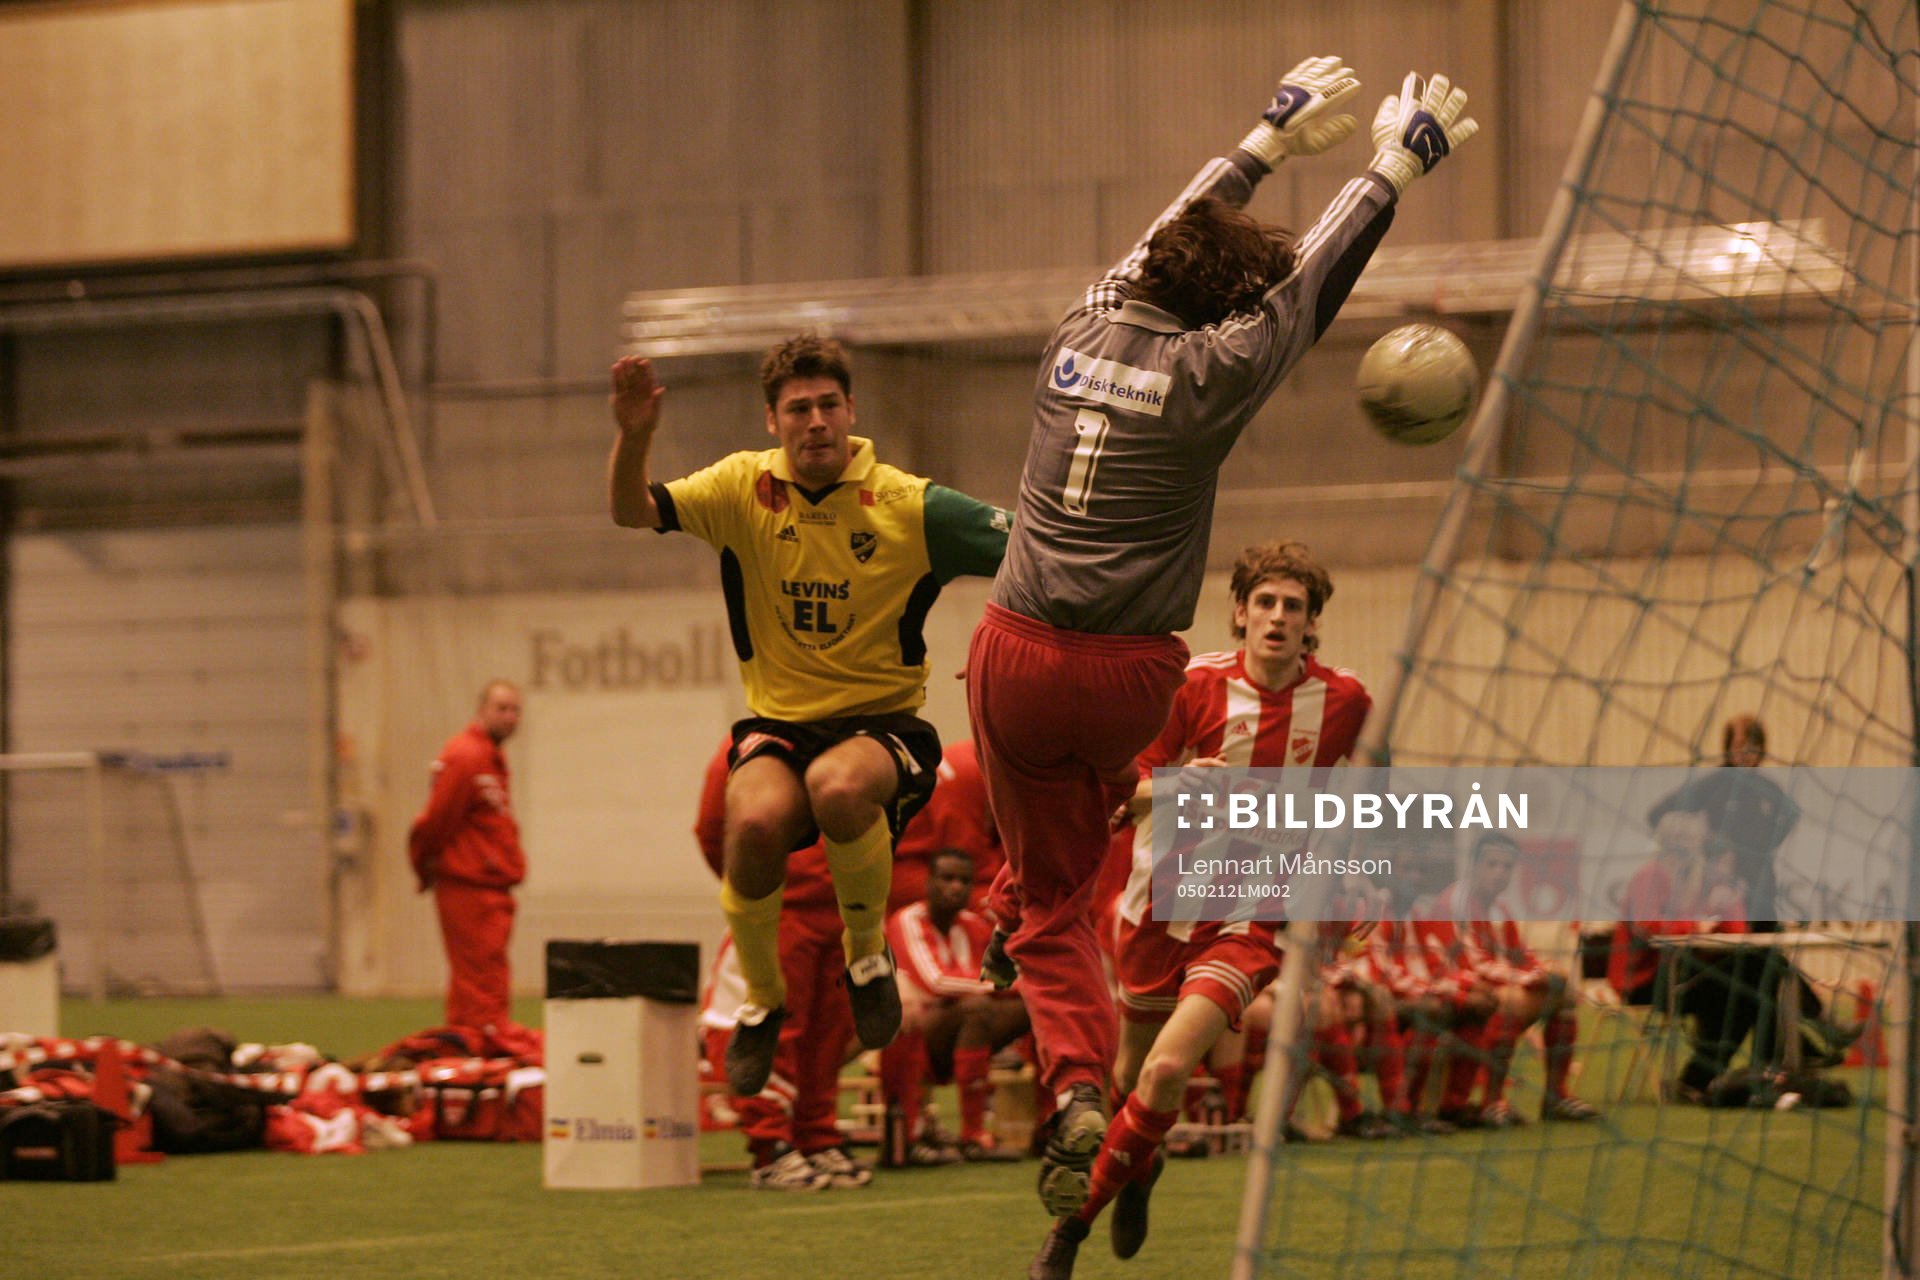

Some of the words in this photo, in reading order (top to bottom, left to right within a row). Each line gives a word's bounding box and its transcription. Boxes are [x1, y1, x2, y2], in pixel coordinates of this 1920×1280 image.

[1080, 375, 1163, 406] Diskteknik
[1063, 408, 1110, 516] 1
[781, 580, 850, 600] LEVINS
[794, 600, 837, 633] EL
[530, 624, 724, 690] Fotboll
